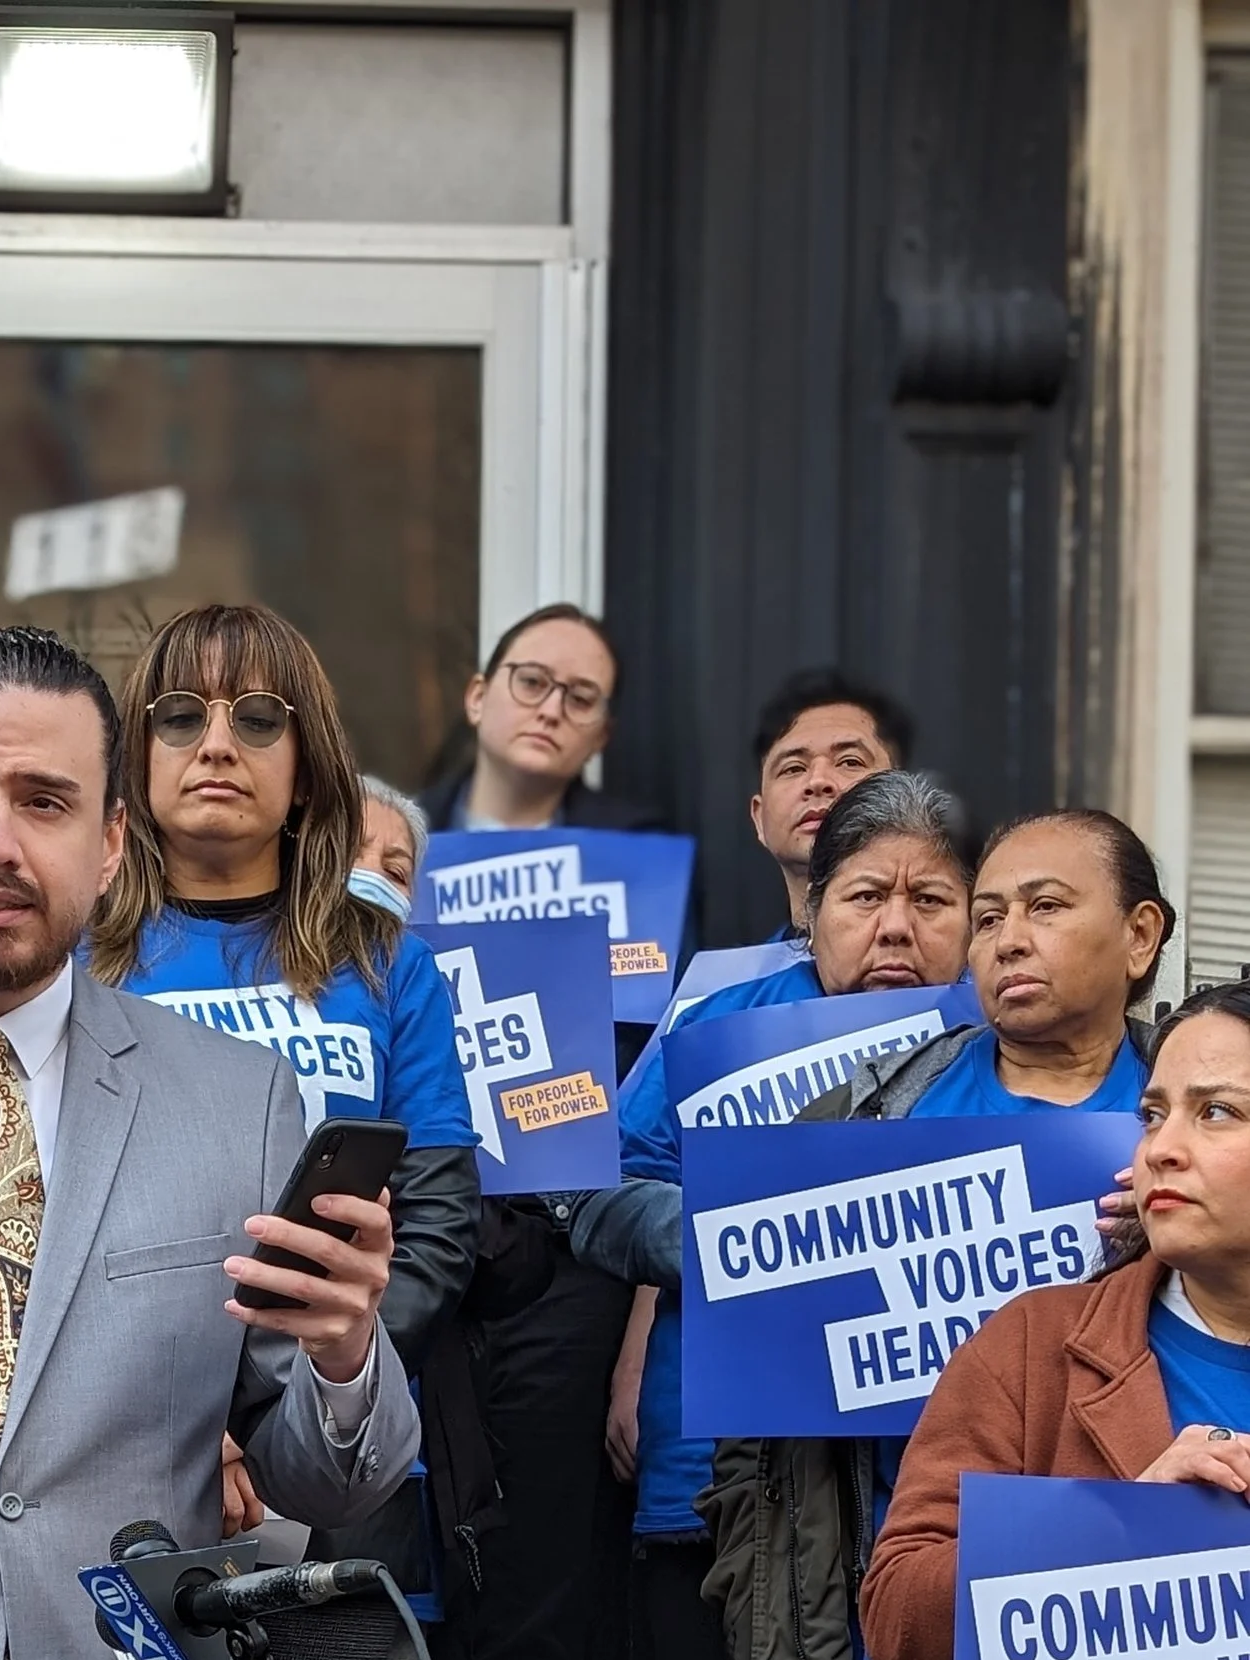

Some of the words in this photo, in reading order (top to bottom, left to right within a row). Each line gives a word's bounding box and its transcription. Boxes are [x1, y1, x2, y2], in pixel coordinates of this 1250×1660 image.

[508, 1092, 534, 1111] FOR
[536, 1079, 590, 1104] PEOPLE.
[524, 1107, 550, 1126] FOR
[553, 1095, 603, 1119] POWER.
[717, 1167, 1008, 1280] COMMUNITY
[899, 1224, 1086, 1309] VOICES
[848, 1309, 997, 1389] HEAR
[116, 1573, 139, 1601] OWN
